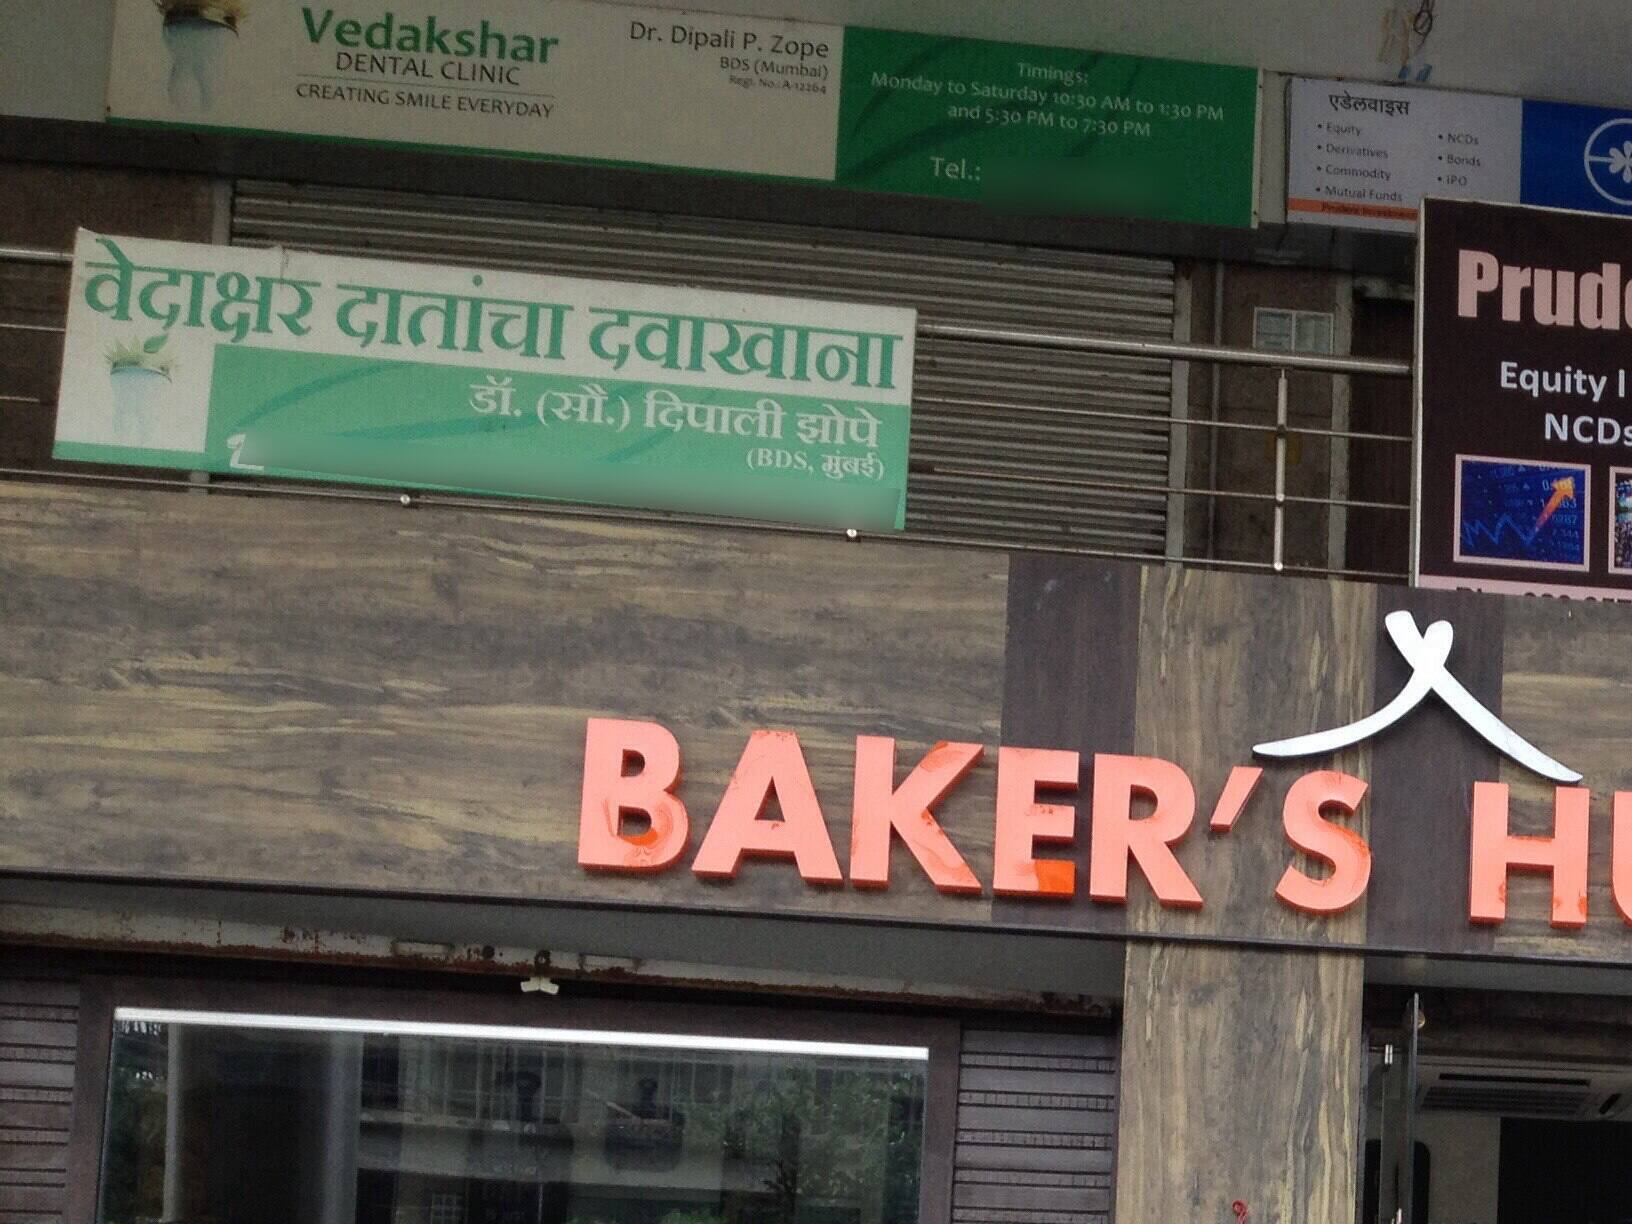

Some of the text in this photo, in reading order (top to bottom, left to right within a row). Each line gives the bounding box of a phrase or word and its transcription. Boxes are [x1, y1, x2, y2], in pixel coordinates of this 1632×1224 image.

[302, 7, 559, 64] Vedakshar
[630, 21, 829, 61] Dr. Dipali P. Zope
[336, 52, 521, 86] DENTAL CLINIC
[720, 56, 828, 81] BDS (Mumbai)
[1017, 62, 1089, 84] Timings:
[296, 83, 554, 118] CREATING SMILE EVERYDAY
[871, 71, 1224, 120] Monday to Saturday 10:30 AM to 1:30 PM
[1329, 91, 1410, 117] एडेलवाइस
[948, 104, 1151, 137] and 5:30 PM to 7:30 PM
[1326, 123, 1361, 136] Equity
[1326, 144, 1389, 159] Derivatives
[1447, 134, 1479, 146] NCDs
[931, 156, 981, 181] Tel.:
[1325, 166, 1392, 181] Commodity
[1447, 154, 1481, 167] Bonds
[1325, 186, 1366, 199] Mutual
[1447, 176, 1468, 186] IPO
[85, 238, 903, 389] वेदाक्षर दातांचा दवाखाना
[1500, 361, 1607, 401] Equity
[536, 384, 631, 432] (सौ.)
[644, 388, 787, 439] दिपाली
[796, 404, 883, 448] झोपे
[745, 447, 814, 474] (BDS,
[575, 714, 1375, 917] BAKER'S
